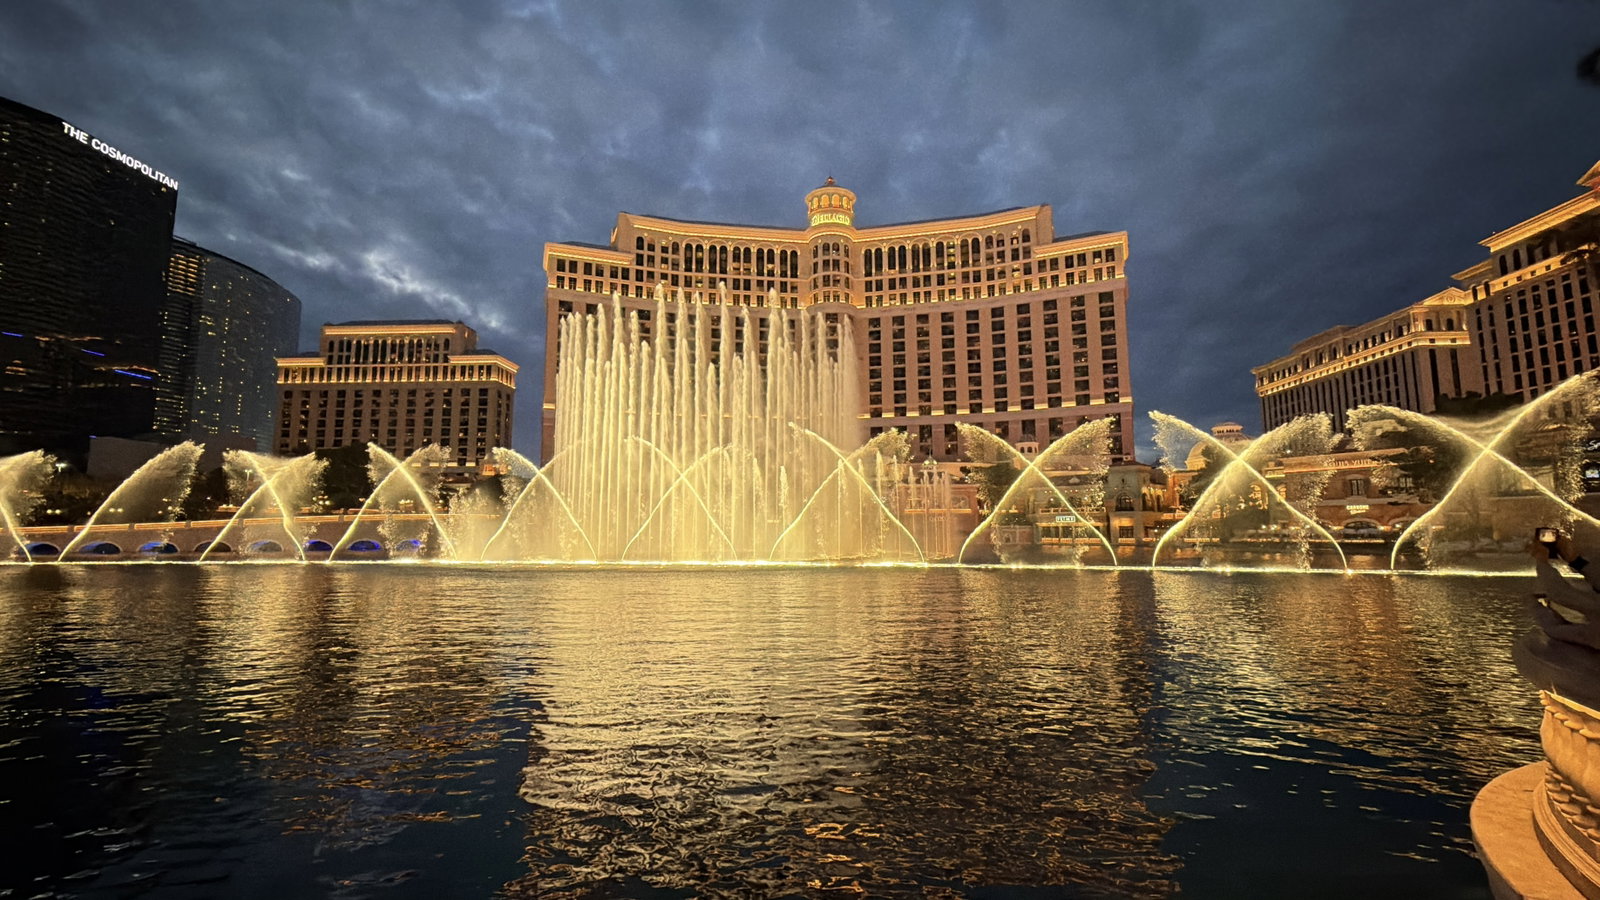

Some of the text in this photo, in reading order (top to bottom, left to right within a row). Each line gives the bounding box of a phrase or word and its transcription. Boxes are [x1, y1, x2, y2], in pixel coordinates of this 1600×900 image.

[62, 121, 178, 190] THE COSMOPOLITAN
[811, 213, 850, 226] BELLAGIO
